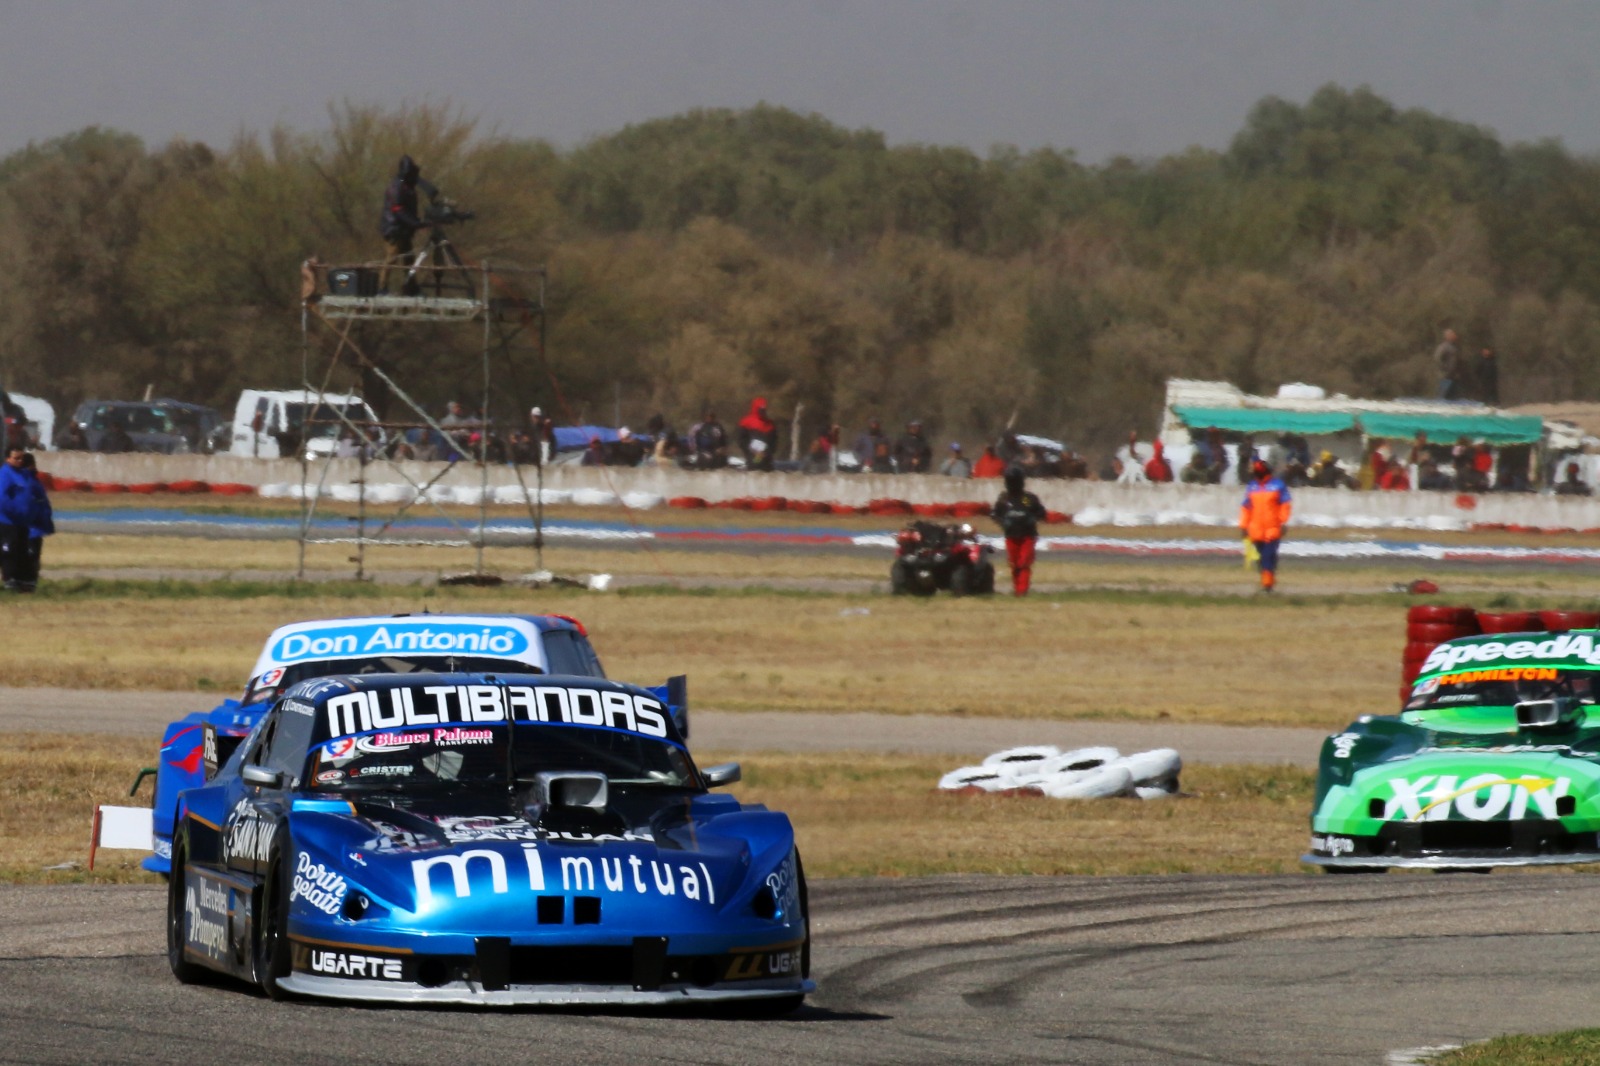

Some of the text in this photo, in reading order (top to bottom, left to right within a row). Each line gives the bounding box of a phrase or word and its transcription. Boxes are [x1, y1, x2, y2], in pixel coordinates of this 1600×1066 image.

[283, 627, 514, 659] Don Antonio
[1440, 668, 1557, 685] HAMILTON
[327, 685, 667, 738] MULTIBANDAS
[374, 727, 493, 747] Blanca Paloma
[434, 738, 493, 747] TRANSPORTES
[1384, 773, 1571, 821] XION
[449, 832, 538, 843] SAN
[296, 851, 348, 898] Porth
[411, 842, 545, 902] mi
[560, 854, 715, 904] mutual
[312, 950, 402, 979] UGARTE
